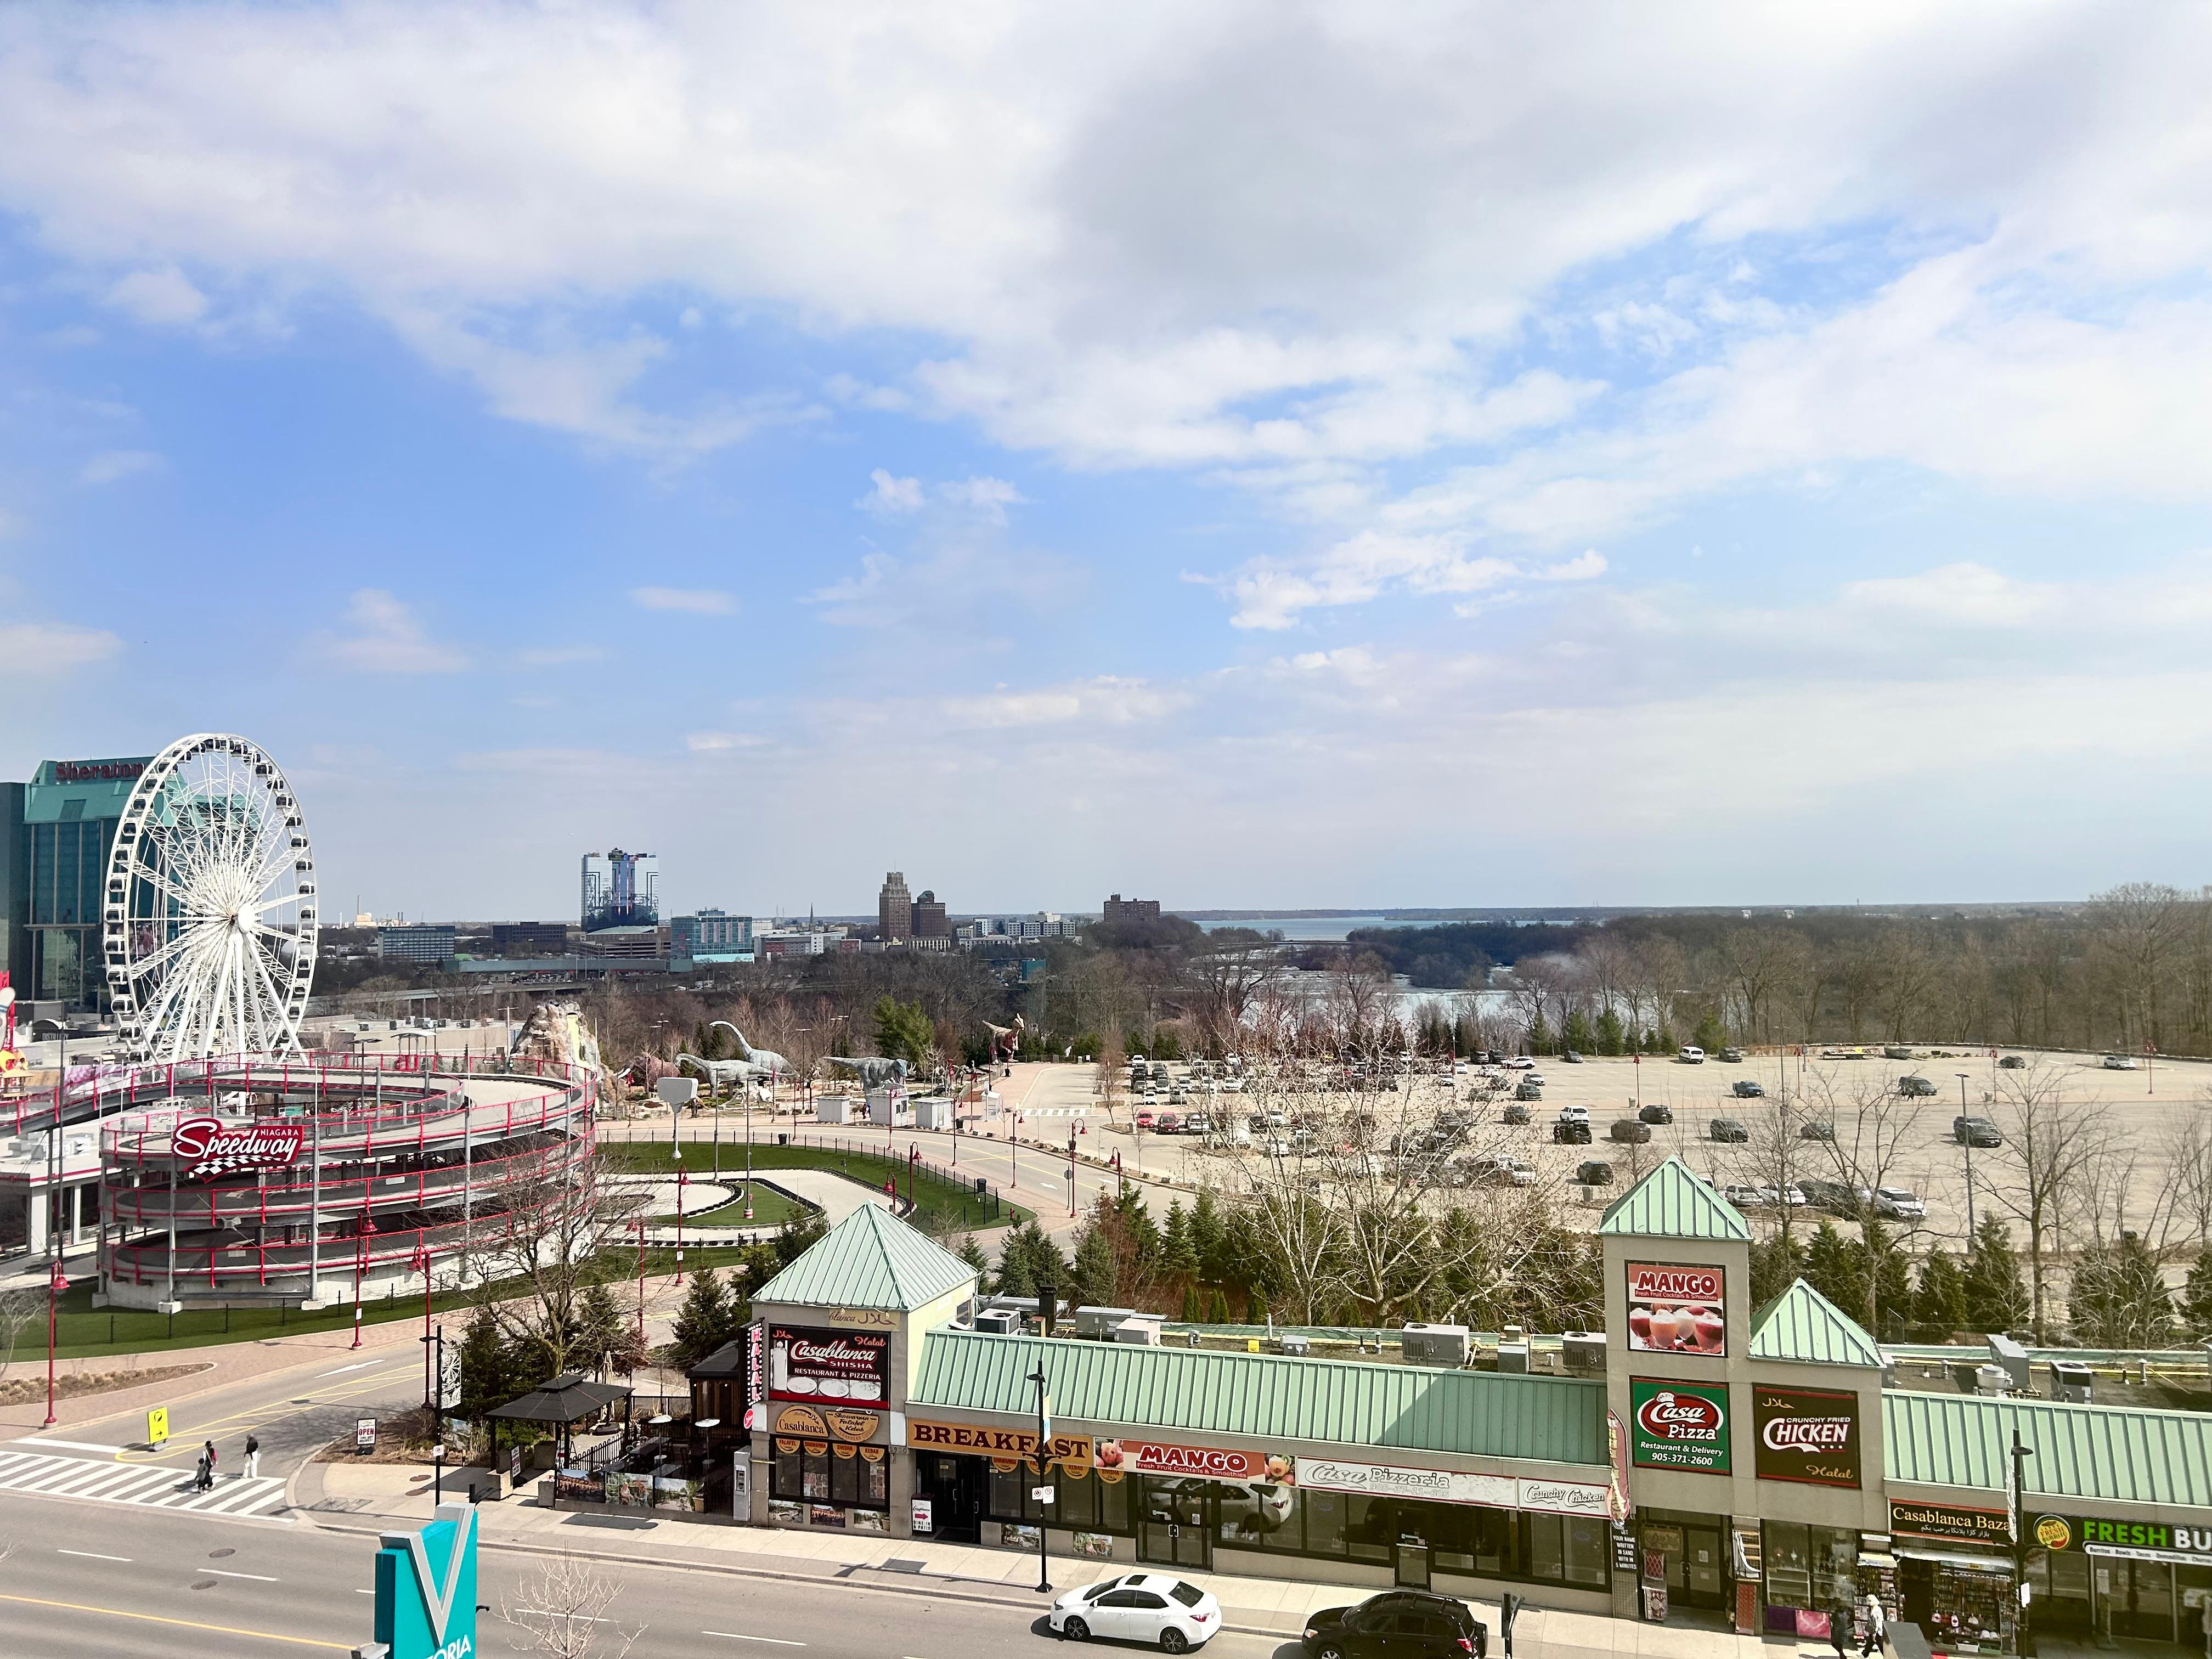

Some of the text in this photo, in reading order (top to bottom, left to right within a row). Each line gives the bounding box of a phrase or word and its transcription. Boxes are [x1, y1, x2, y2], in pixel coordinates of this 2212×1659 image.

[55, 761, 144, 781] Sheraton
[173, 1121, 298, 1162] Speedway
[1638, 1272, 1717, 1295] MANGO
[857, 1312, 896, 1325] حلال
[772, 1330, 794, 1339] حلال
[854, 1336, 886, 1347] Halal
[791, 1340, 876, 1362] Casablanca
[751, 1328, 760, 1400] HALAL
[830, 1361, 873, 1369] SHISHA
[794, 1368, 838, 1377] RESTAURANT
[1762, 1397, 1795, 1409] حلال
[834, 1413, 868, 1421] Shawarma
[1650, 1402, 1706, 1424] Casa
[779, 1419, 825, 1434] Casablanca
[1668, 1424, 1716, 1440] Pizza
[913, 1424, 1088, 1458] BREAKFAST
[1763, 1418, 1848, 1453] CHICKEN
[1640, 1441, 1680, 1452] Restaurant
[1691, 1446, 1724, 1457] Delivery
[1139, 1446, 1248, 1472] MANGO
[1651, 1452, 1713, 1466] 905-371-2600
[1173, 1465, 1203, 1474] Cocktails
[1211, 1470, 1247, 1479] Smoothies
[1305, 1463, 1450, 1489] Casa Pizzeria
[1806, 1465, 1854, 1479] Halal
[1523, 1483, 1605, 1509] Crunchy Chicken
[1893, 1507, 2010, 1531] Casablanca Baza
[2040, 1526, 2064, 1537] FRESH
[2042, 1532, 2068, 1542] BURRITO
[2084, 1521, 2167, 1547] FRESH
[426, 1634, 472, 1659] ORIA
